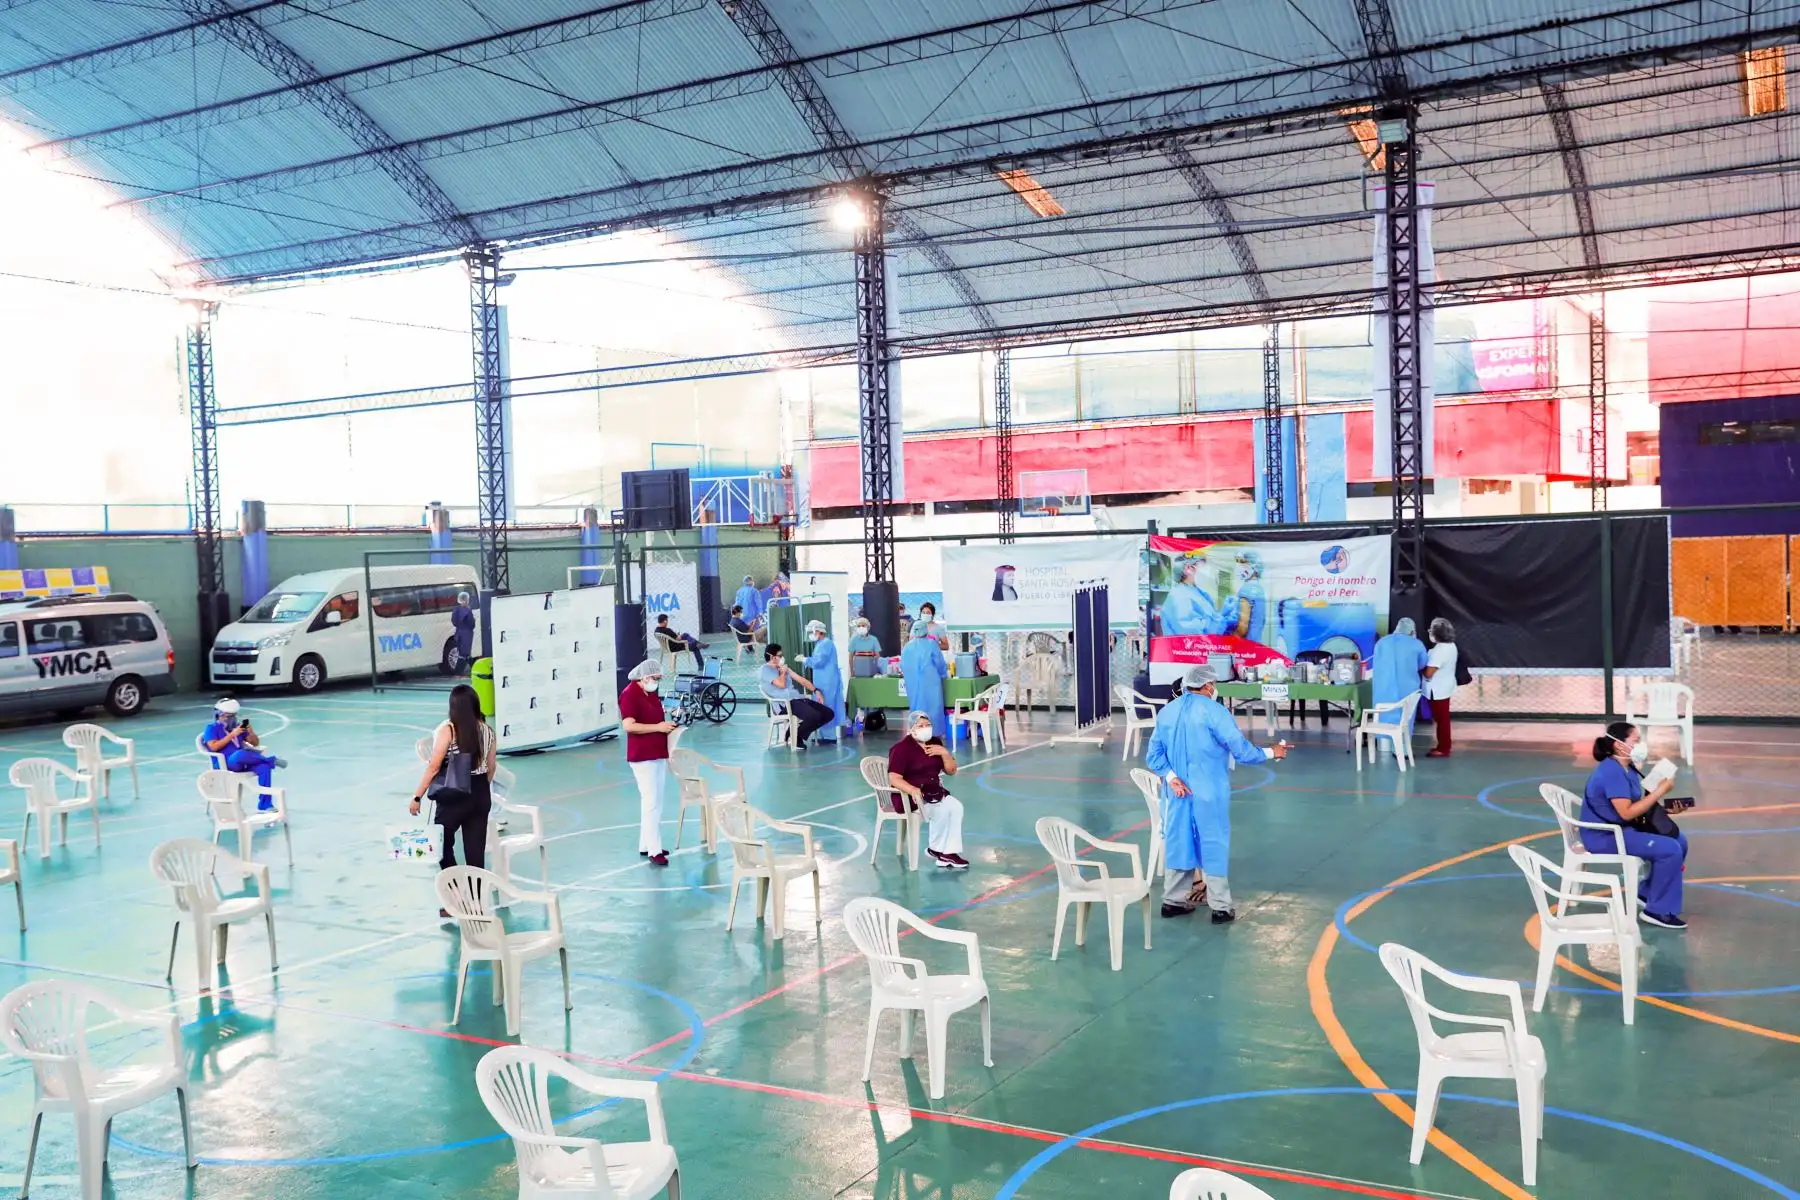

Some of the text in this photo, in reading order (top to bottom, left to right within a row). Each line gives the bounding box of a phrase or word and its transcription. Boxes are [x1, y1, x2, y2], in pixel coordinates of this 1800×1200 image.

[1025, 566, 1067, 577] HOSPITAL
[1294, 576, 1325, 587] Ponga
[1326, 576, 1336, 585] el
[1053, 591, 1071, 599] LIBR
[1308, 589, 1326, 599] por
[1327, 588, 1337, 597] el
[640, 592, 681, 613] MCA
[378, 632, 422, 653] YMCA
[32, 650, 113, 678] YMCA
[1263, 685, 1288, 694] MINSA
